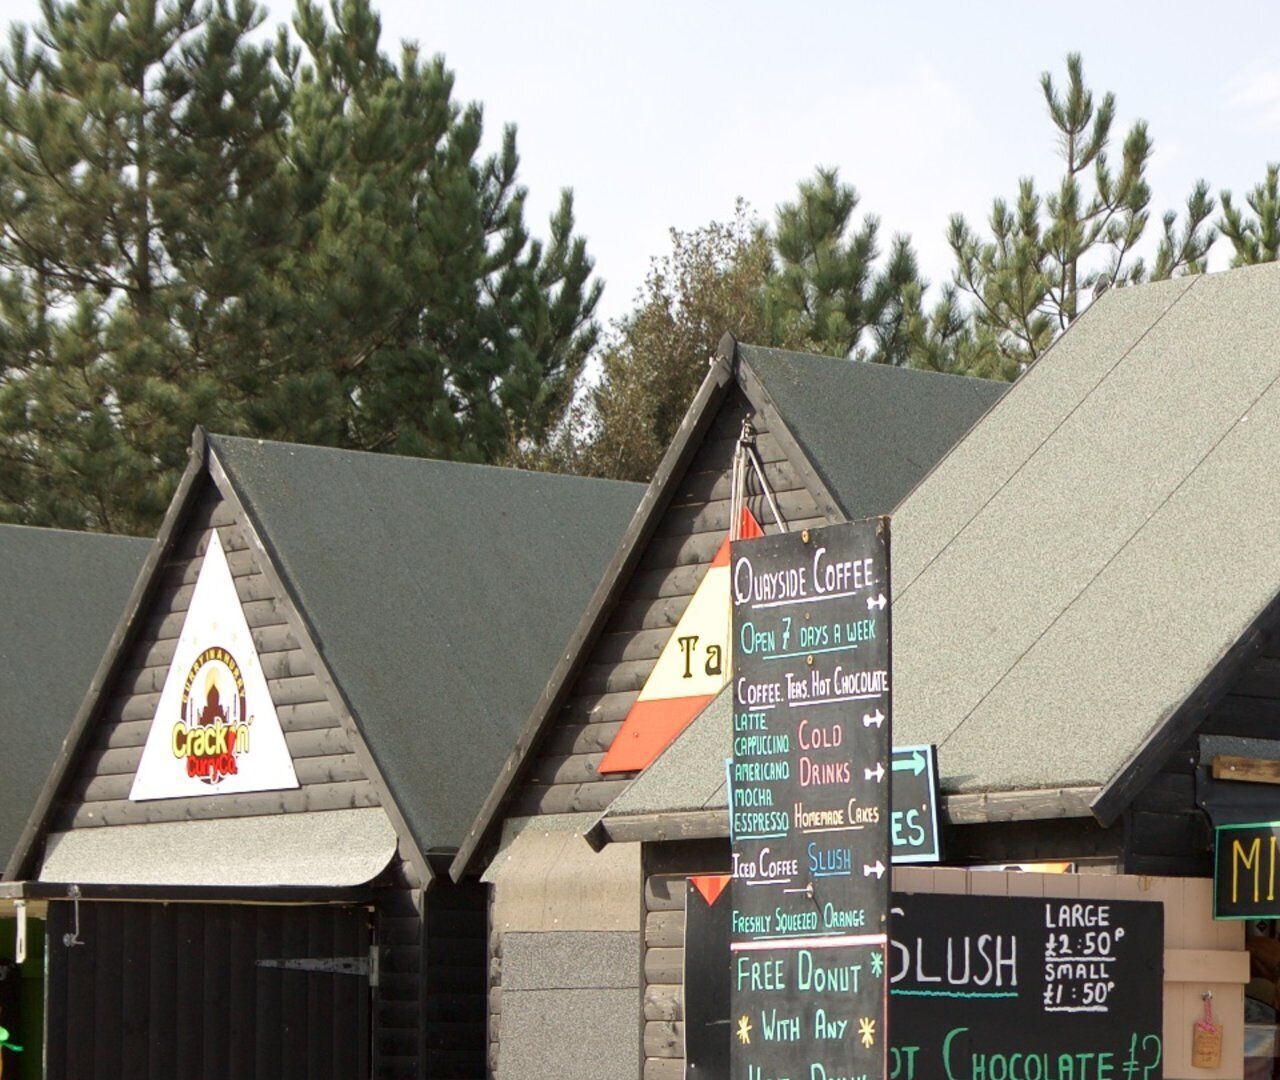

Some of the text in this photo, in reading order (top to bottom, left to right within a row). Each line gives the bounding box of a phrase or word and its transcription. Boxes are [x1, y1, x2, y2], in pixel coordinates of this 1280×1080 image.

[734, 556, 806, 605] QUAYSIDE
[741, 617, 876, 654] OPEN 7 DAYS A WEEK
[811, 670, 831, 697] HOT
[833, 666, 889, 695] CHOCOLATE
[734, 734, 790, 756] CAPPUCCINO
[798, 719, 842, 750] COLD
[734, 756, 850, 787] AMERICANO DRINKS
[734, 798, 880, 834] ESSPRESSO HOMEMADE CAKES
[732, 842, 851, 878] ICED COFFEE SLUSH
[732, 902, 865, 934] FRESHLY SQUEEZED ORANGE
[1045, 904, 1110, 928] LARGE
[737, 950, 861, 993] FREE DONUT
[1045, 963, 1109, 982] SMALL
[761, 1009, 848, 1041] WITH ANY
